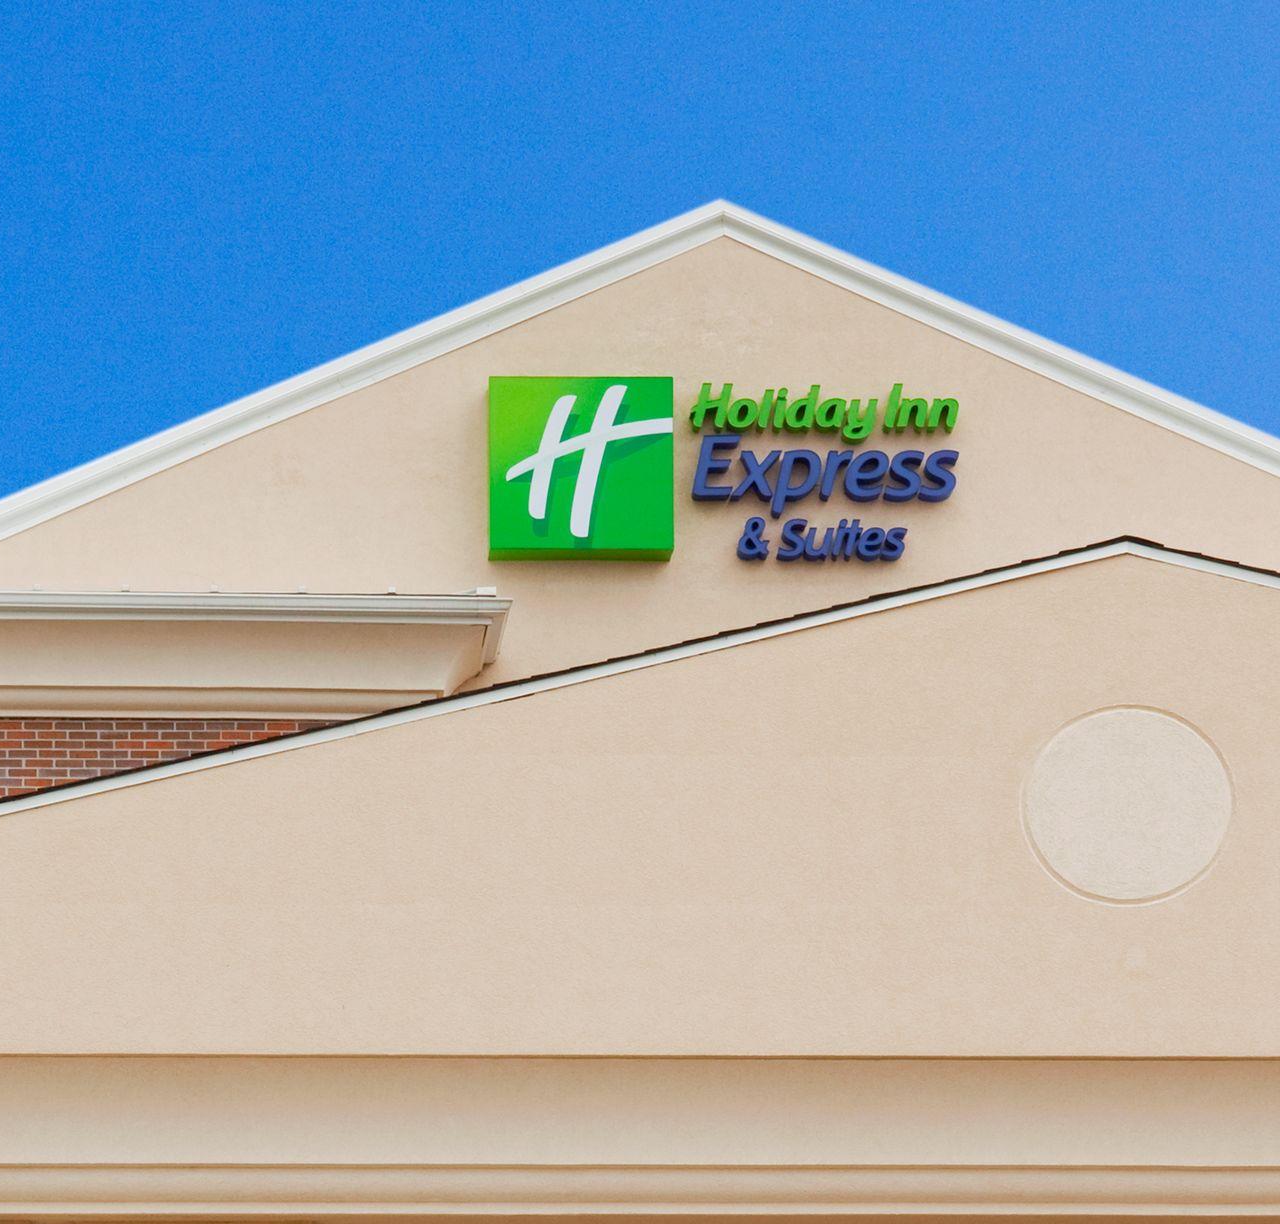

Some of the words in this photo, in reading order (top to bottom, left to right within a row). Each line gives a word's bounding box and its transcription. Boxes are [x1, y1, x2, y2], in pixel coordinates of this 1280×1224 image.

[690, 383, 879, 443] Holiday
[883, 383, 959, 433] Inn
[505, 385, 673, 537] H
[692, 435, 960, 517] Express
[737, 516, 768, 561] &
[776, 519, 907, 562] Suites
